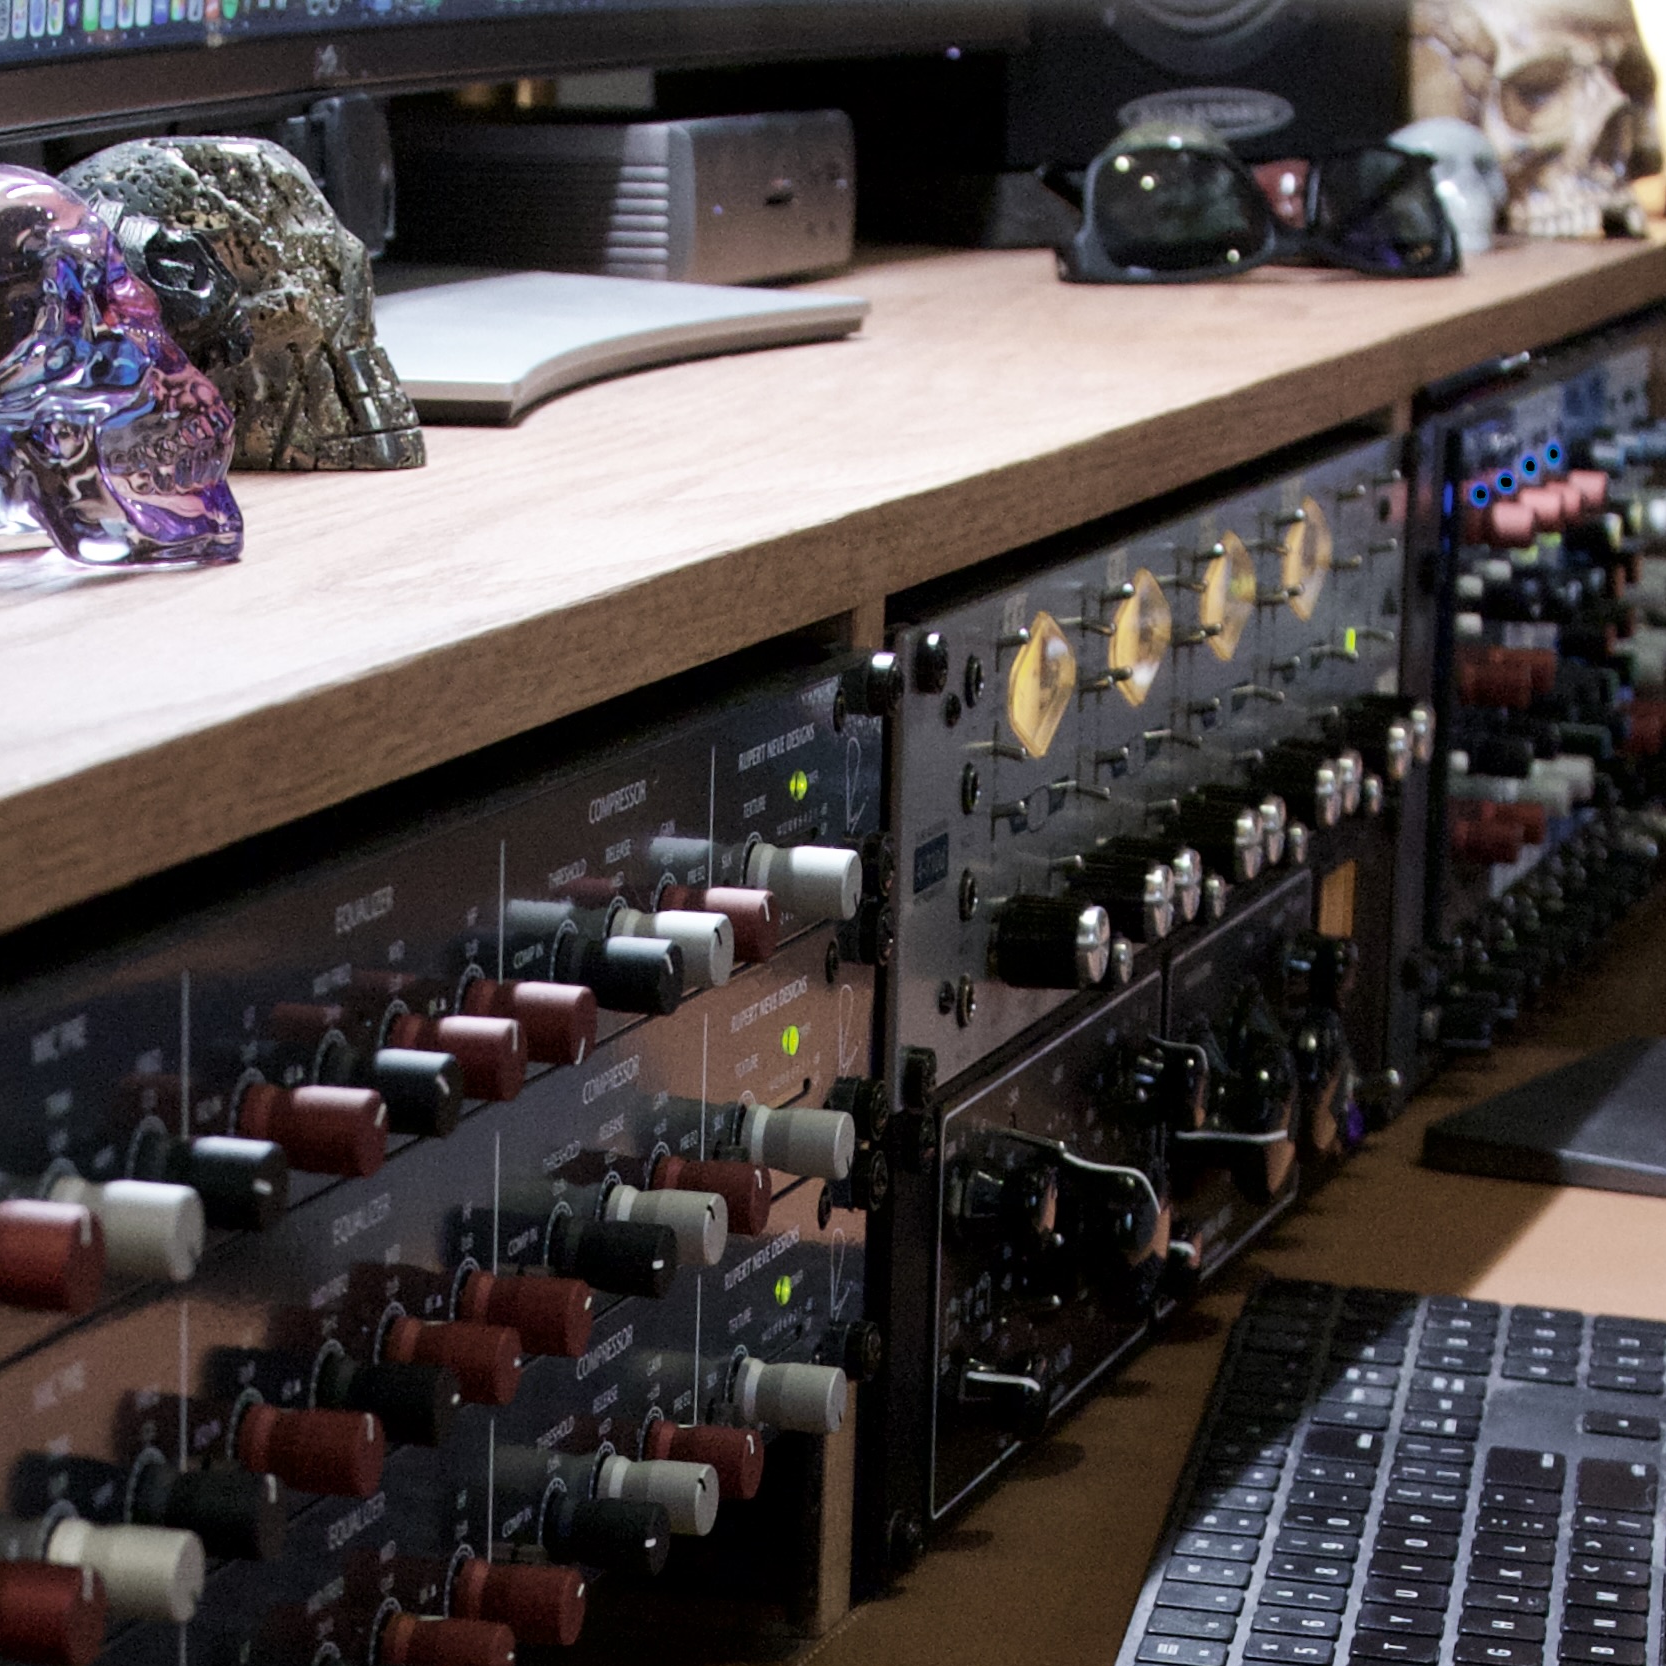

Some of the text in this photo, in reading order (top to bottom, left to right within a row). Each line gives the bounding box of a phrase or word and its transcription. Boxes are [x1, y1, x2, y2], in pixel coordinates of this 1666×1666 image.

[738, 722, 815, 772] RUPERT NEVE DESIGNS
[589, 779, 647, 825] COMPRESSOR
[604, 839, 632, 864] RELEASE
[335, 885, 394, 935] EQUALIZER
[730, 1003, 759, 1033] RUPERT
[759, 992, 778, 1015] NEVE
[582, 1054, 640, 1105] COMPRESSOR
[332, 1192, 391, 1245] EQUALIZER
[724, 1225, 800, 1292] RUPERT NEVE DESIGNS
[576, 1324, 633, 1381] COMPRESSOR
[327, 1490, 386, 1551] EQUALIZER
[1409, 1514, 1431, 1523] P
[1321, 1542, 1345, 1550] 9
[1404, 1538, 1429, 1548] O
[1504, 1545, 1527, 1553] L
[1314, 1567, 1338, 1576] 8
[1499, 1568, 1522, 1578] K
[1307, 1592, 1331, 1601] 7
[1395, 1589, 1419, 1599] U
[1496, 1594, 1520, 1603] J
[1596, 1591, 1618, 1602] M
[1301, 1619, 1325, 1628] 6
[1389, 1615, 1413, 1623] Y
[1593, 1618, 1617, 1628] N
[1492, 1620, 1515, 1630] H
[1293, 1647, 1318, 1655] 5
[1383, 1642, 1407, 1650] T
[1590, 1646, 1615, 1655] B
[1486, 1648, 1512, 1657] G
